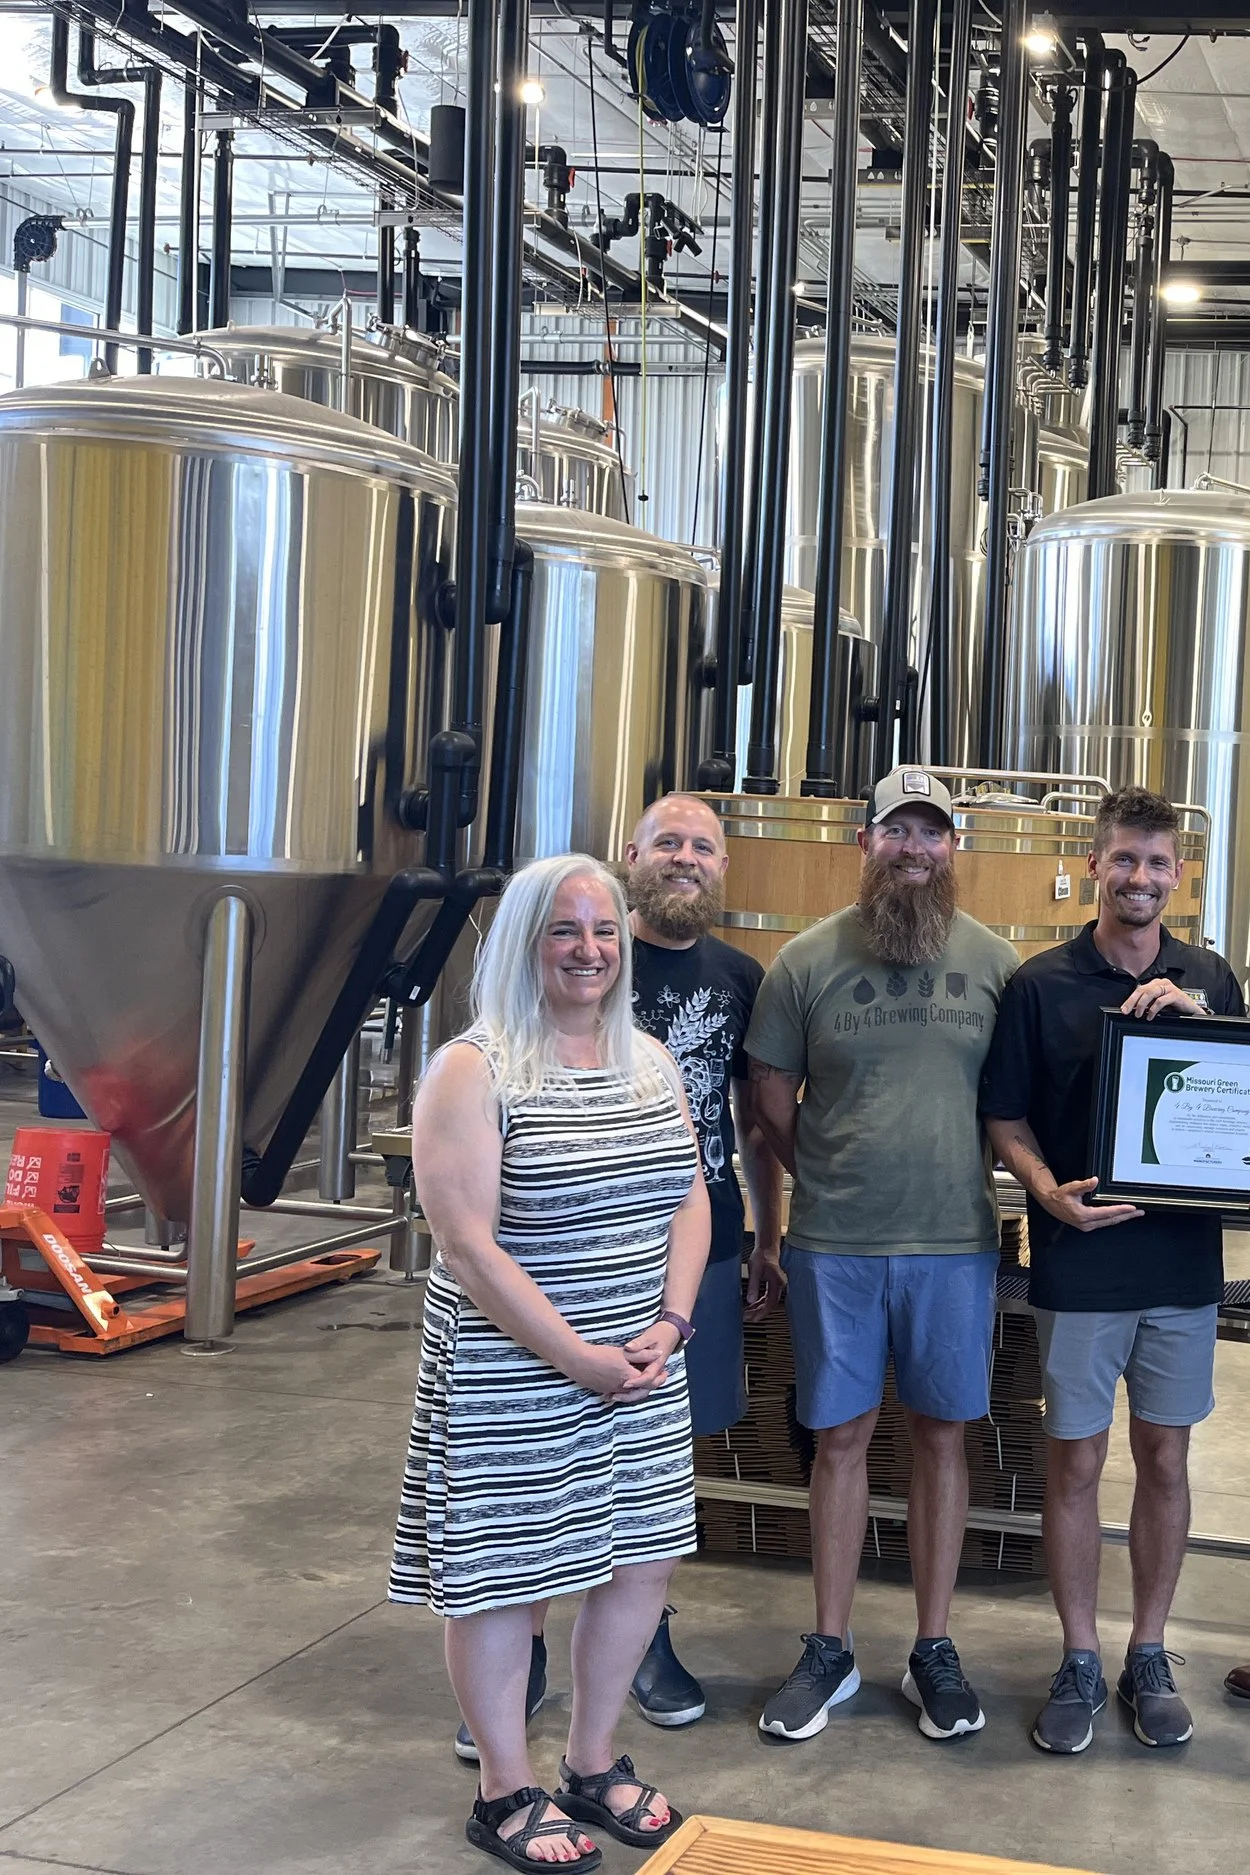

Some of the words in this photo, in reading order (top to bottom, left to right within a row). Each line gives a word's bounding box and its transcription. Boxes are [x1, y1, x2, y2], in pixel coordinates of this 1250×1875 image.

[834, 1013, 841, 1033] 4
[844, 1011, 861, 1035] By
[863, 1008, 872, 1028] 4
[875, 1002, 928, 1027] Brewing
[930, 1002, 985, 1032] Company
[1186, 1077, 1216, 1086] Missouri
[1217, 1079, 1239, 1087] Green
[1186, 1084, 1216, 1094] Brewery
[42, 1234, 93, 1295] DOOSAN
